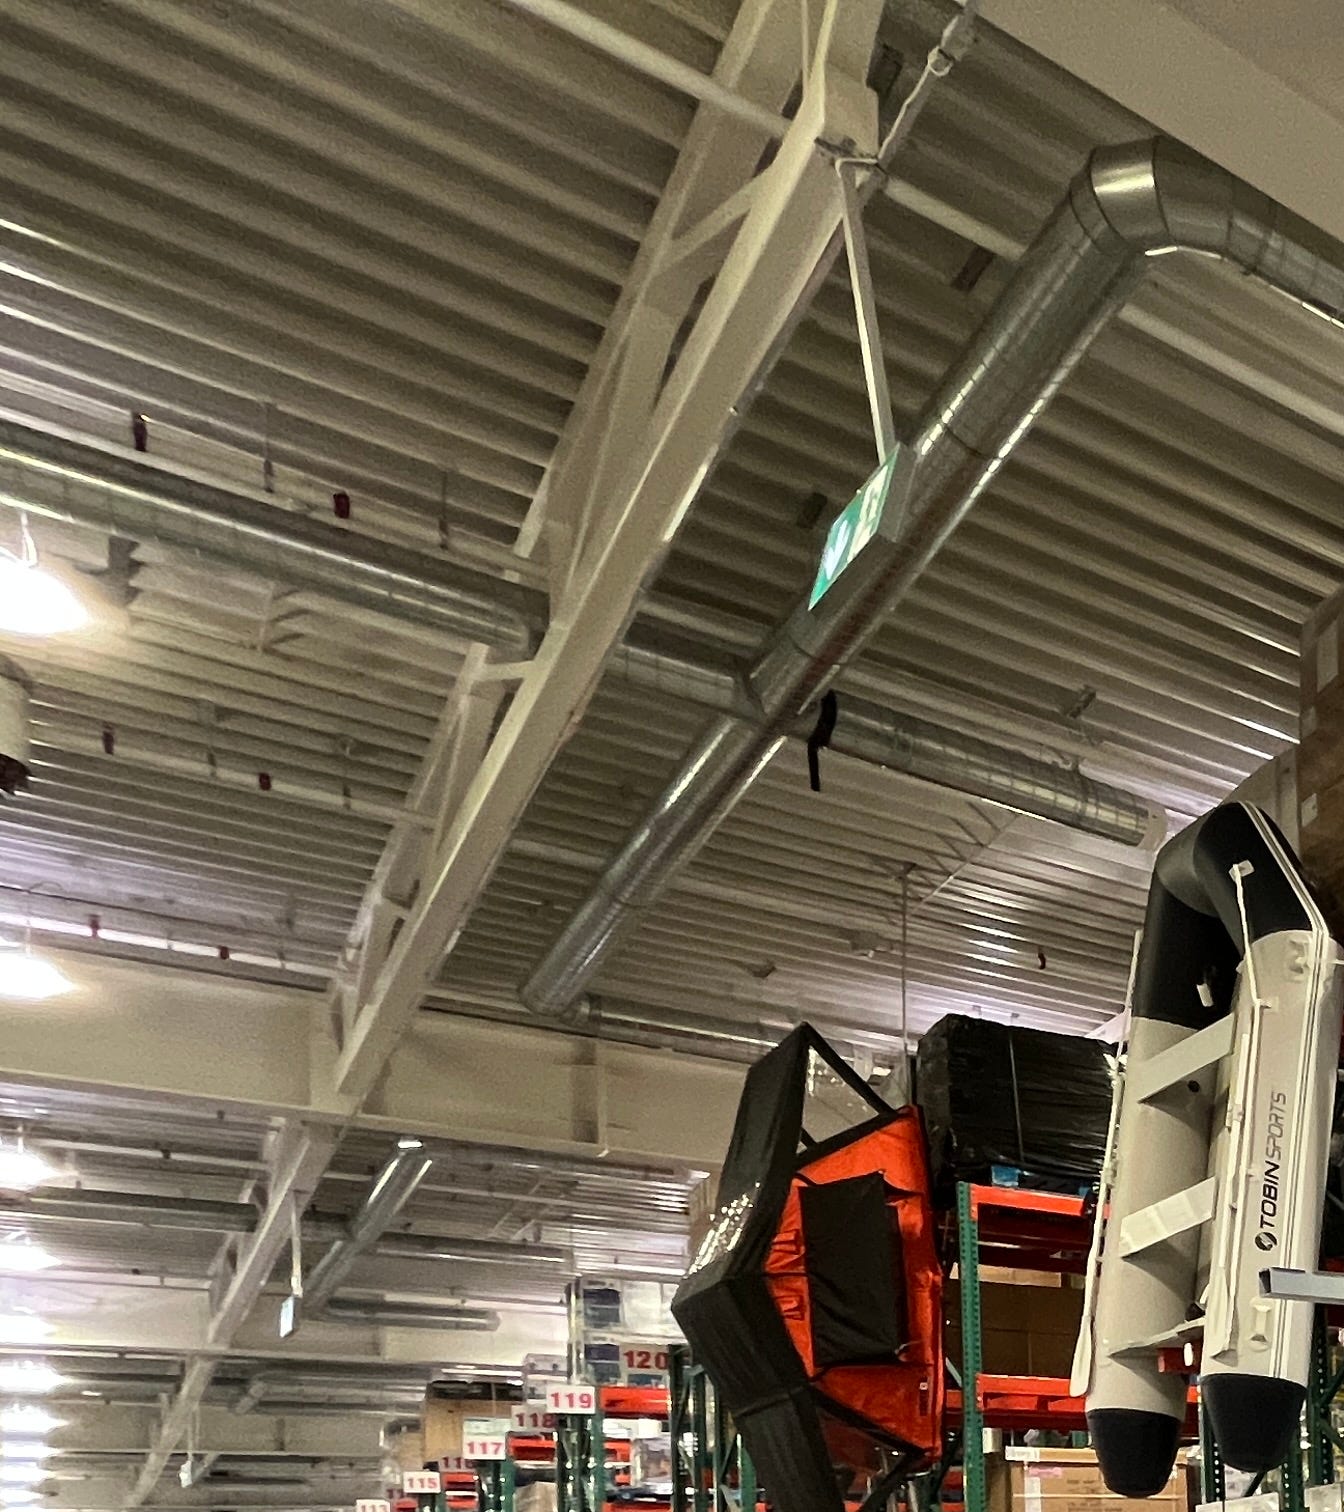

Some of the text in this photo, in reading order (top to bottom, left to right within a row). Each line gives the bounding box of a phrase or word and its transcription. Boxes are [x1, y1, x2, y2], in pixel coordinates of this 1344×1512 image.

[624, 1350, 669, 1369] 120
[550, 1392, 592, 1408] 119
[515, 1412, 556, 1428] 118
[467, 1442, 503, 1456] 117
[407, 1477, 438, 1489] 115
